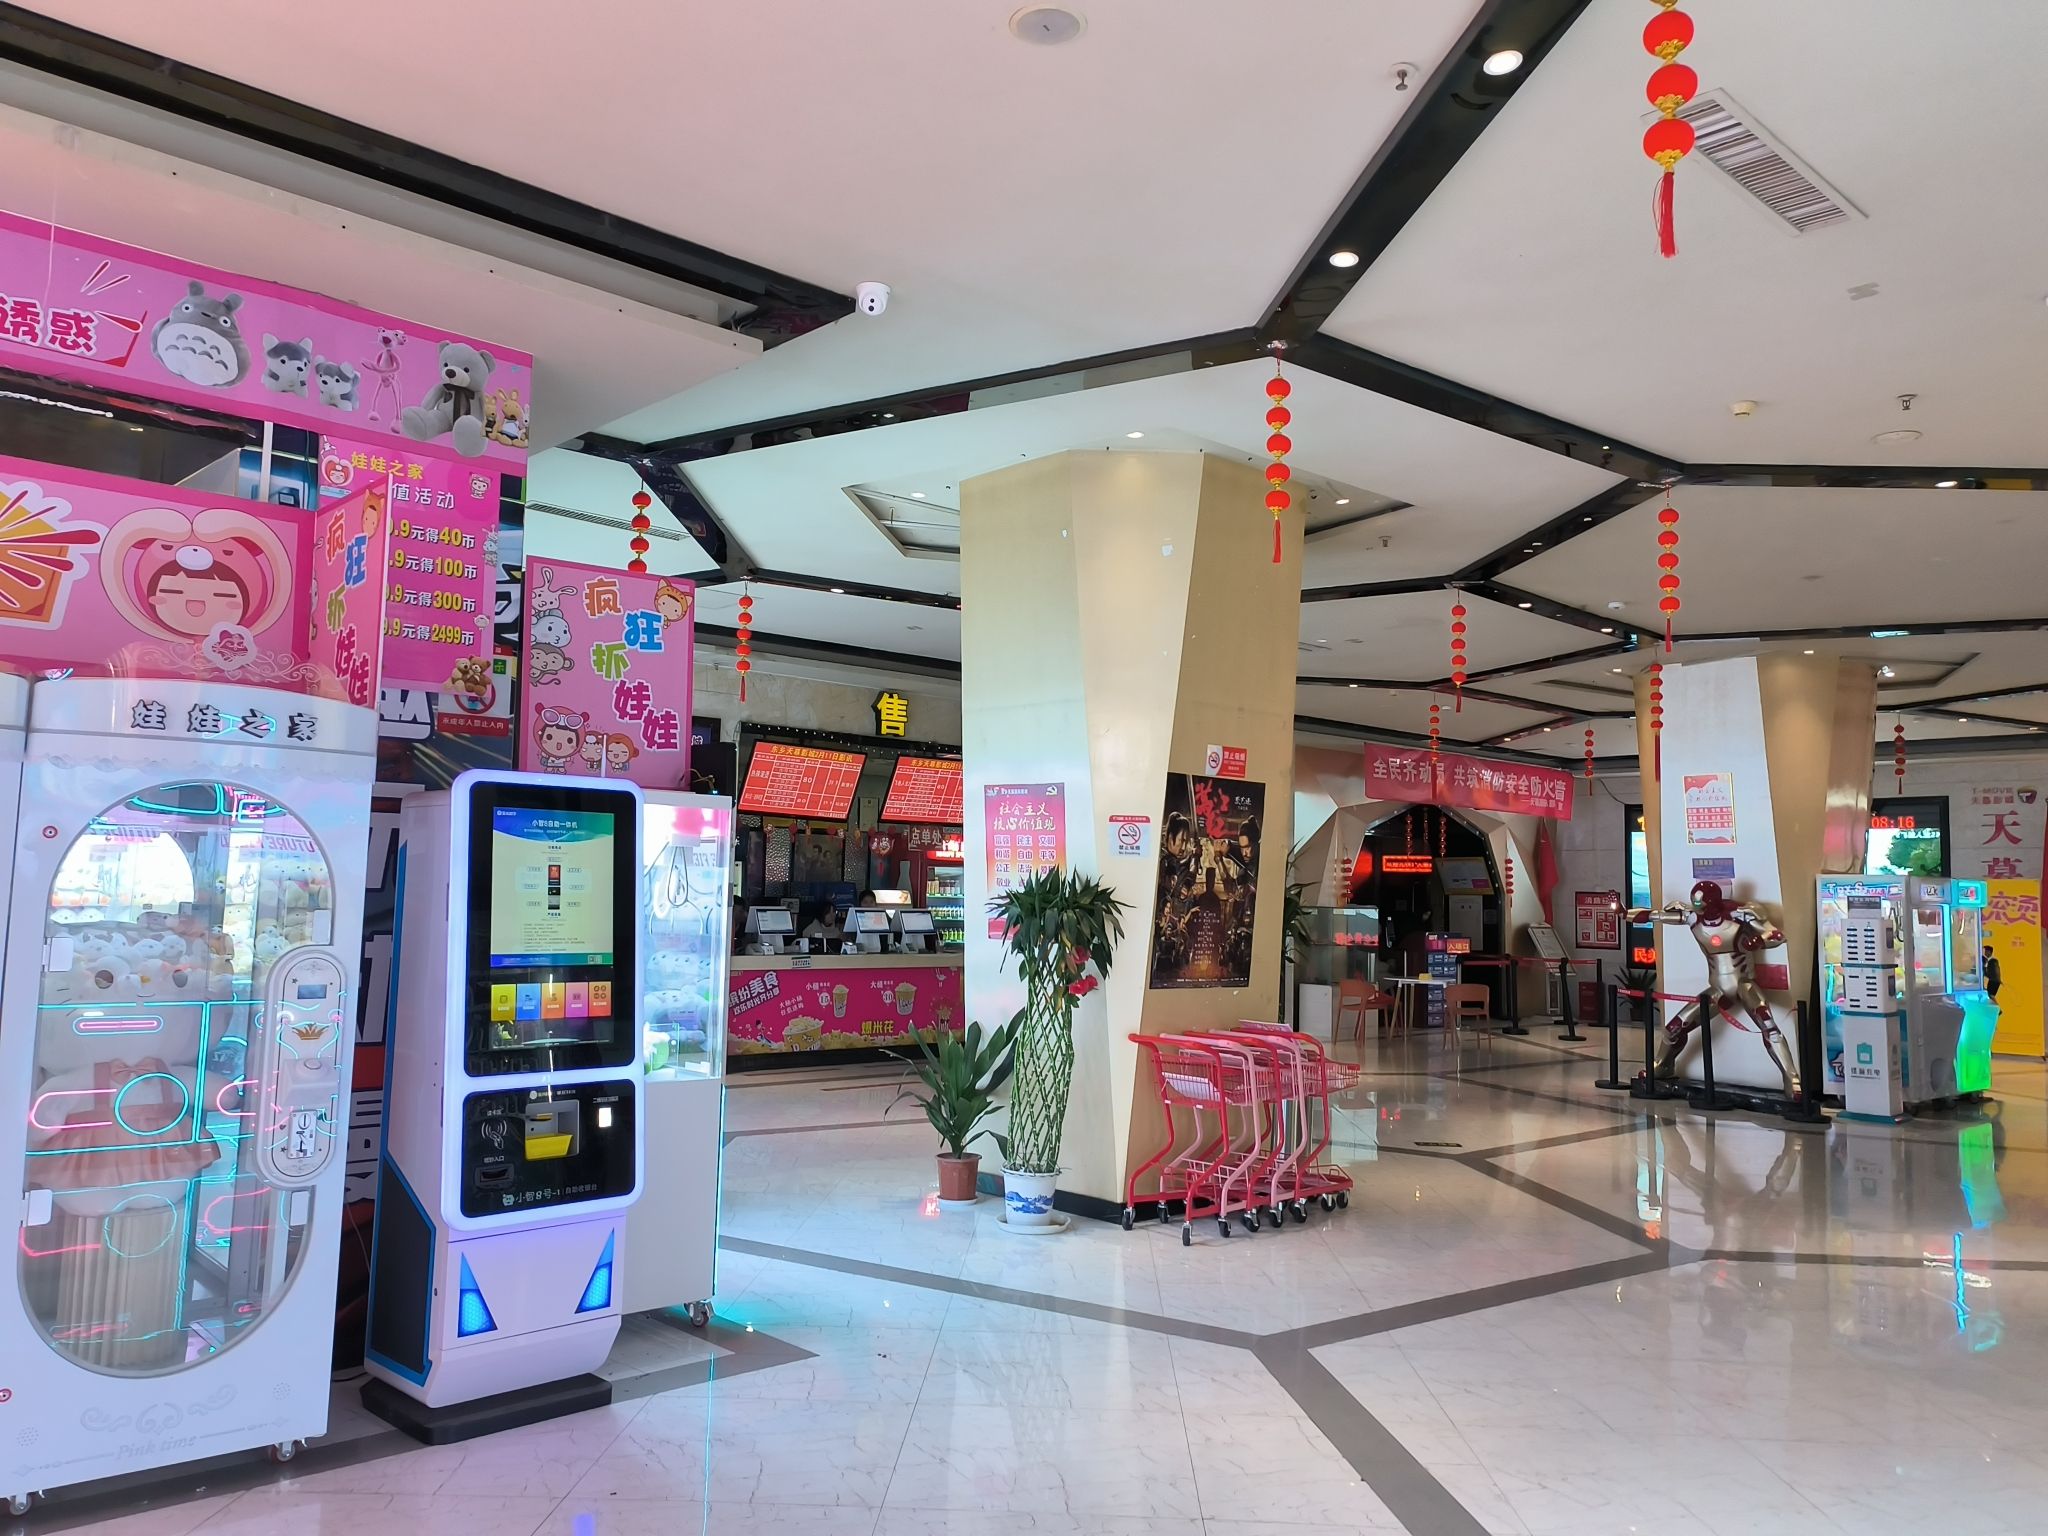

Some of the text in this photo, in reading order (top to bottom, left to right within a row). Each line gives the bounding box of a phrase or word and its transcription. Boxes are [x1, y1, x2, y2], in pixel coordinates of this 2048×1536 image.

[0, 295, 97, 354] 诱惑
[351, 451, 424, 480] 娃娃之家
[326, 509, 371, 706] 疯狂抓娃娃
[583, 575, 681, 751] 疯狂抓娃娃
[131, 699, 319, 742] 娃娃之家
[876, 693, 909, 737] 售
[993, 817, 1056, 831] 核心价值观
[999, 801, 1050, 816] 社会主义
[1871, 815, 1915, 829] 08:16
[1017, 850, 1032, 860] 自由
[1040, 850, 1055, 860] 平等
